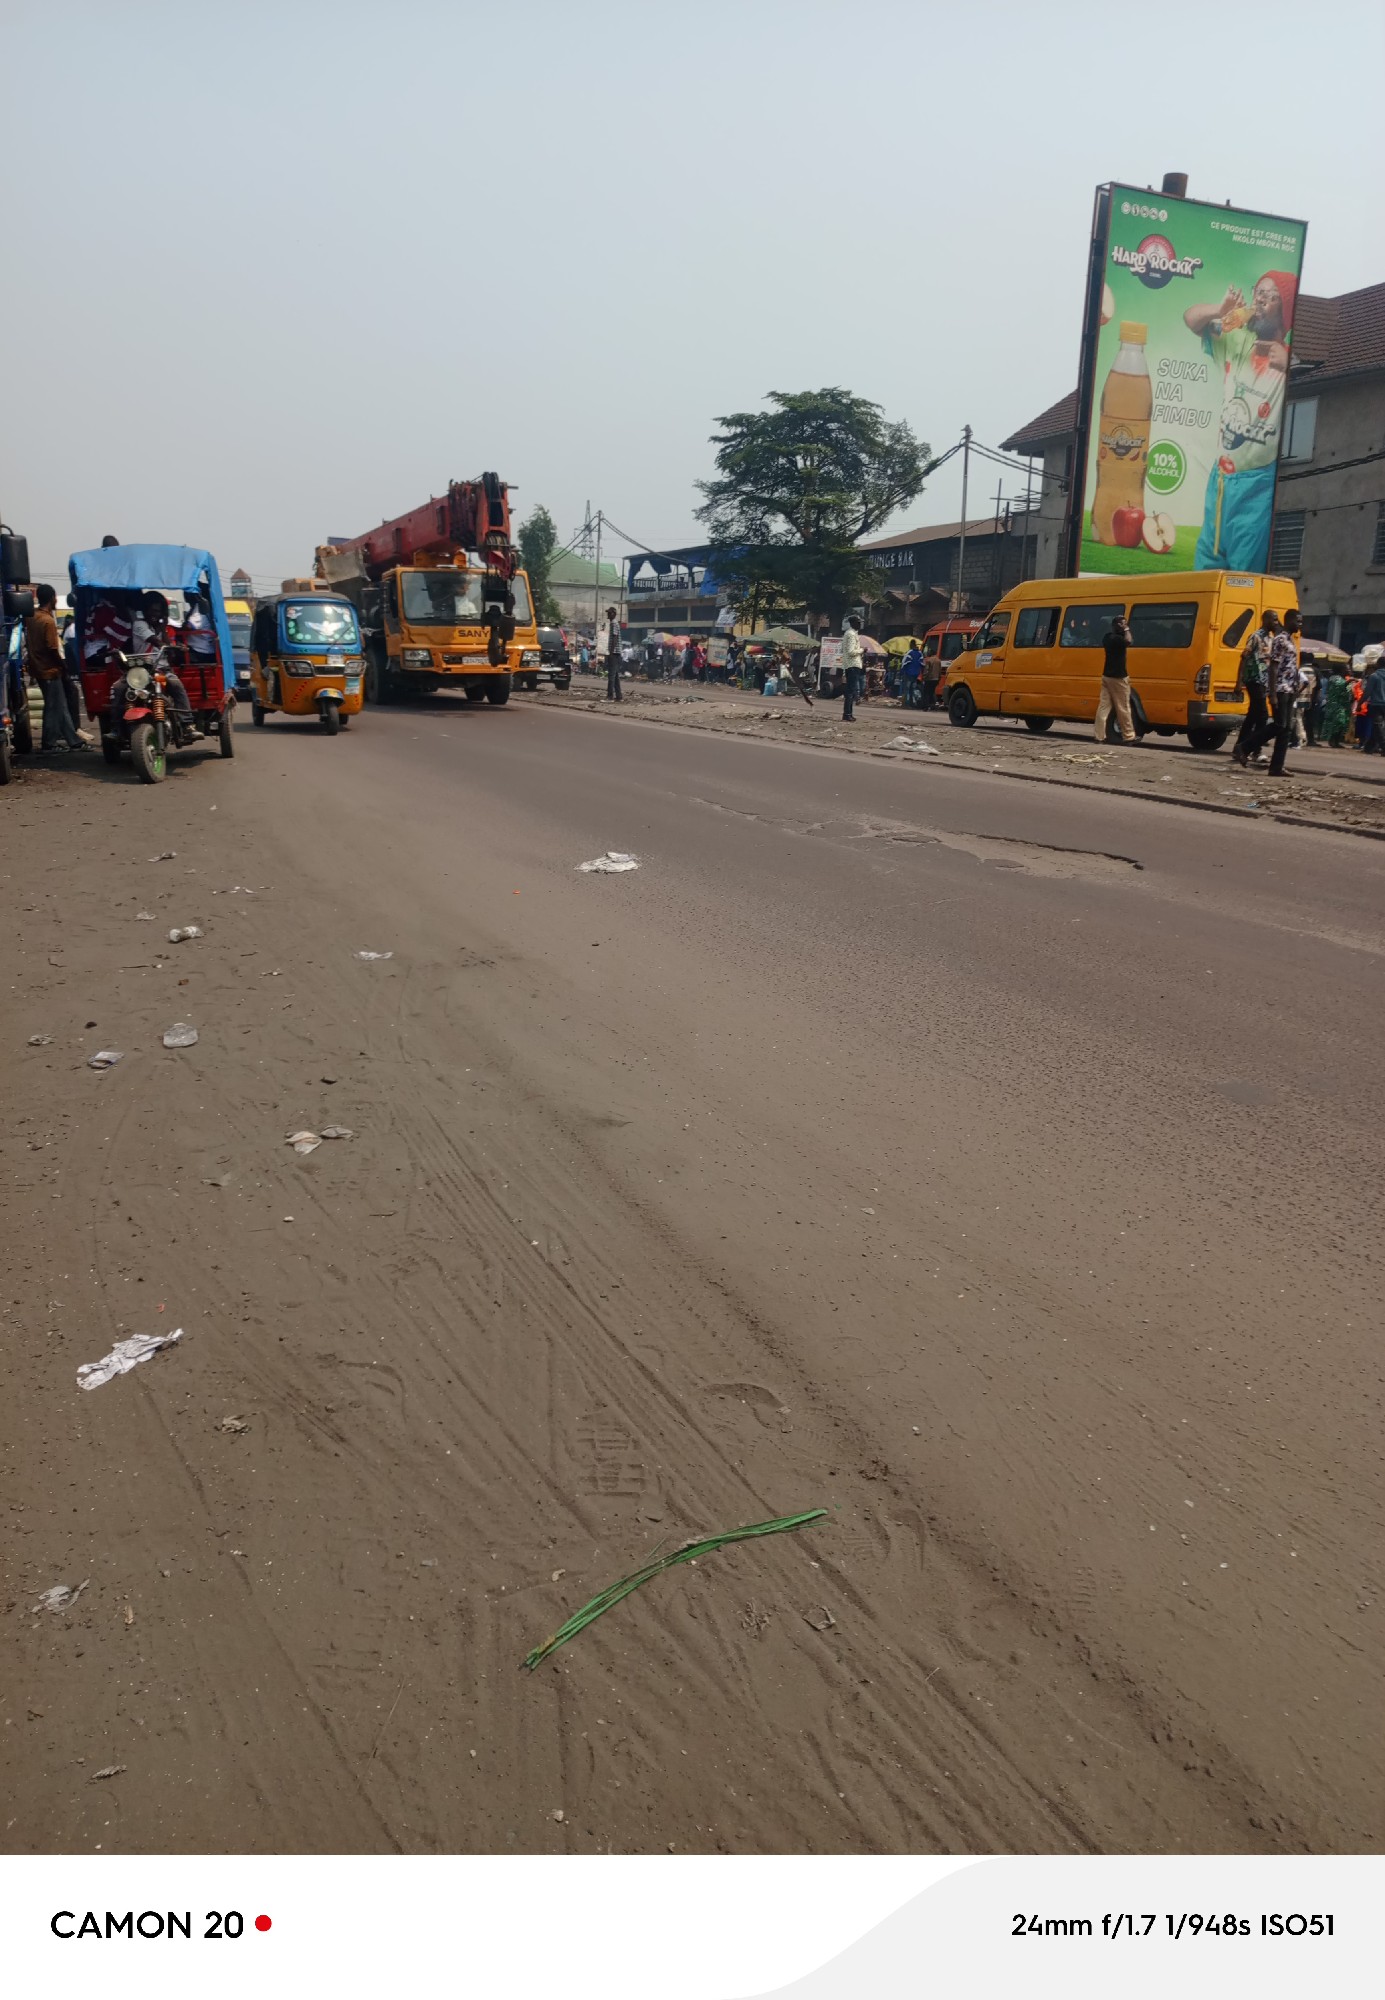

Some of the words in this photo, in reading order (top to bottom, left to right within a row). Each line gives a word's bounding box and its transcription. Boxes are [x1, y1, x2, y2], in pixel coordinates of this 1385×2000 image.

[1210, 221, 1220, 230] CE
[1221, 223, 1251, 235] PRODUIT
[1251, 229, 1265, 238] EST
[1283, 235, 1296, 244] PAR
[1112, 246, 1147, 274] HARD
[1157, 358, 1208, 383] SUKA
[1155, 381, 1183, 402] NA
[1153, 404, 1212, 429] FIMBU
[1153, 453, 1178, 468] 10%
[1148, 467, 1180, 478] ALCOHOL
[897, 550, 914, 567] BAR
[458, 629, 490, 638] SANY
